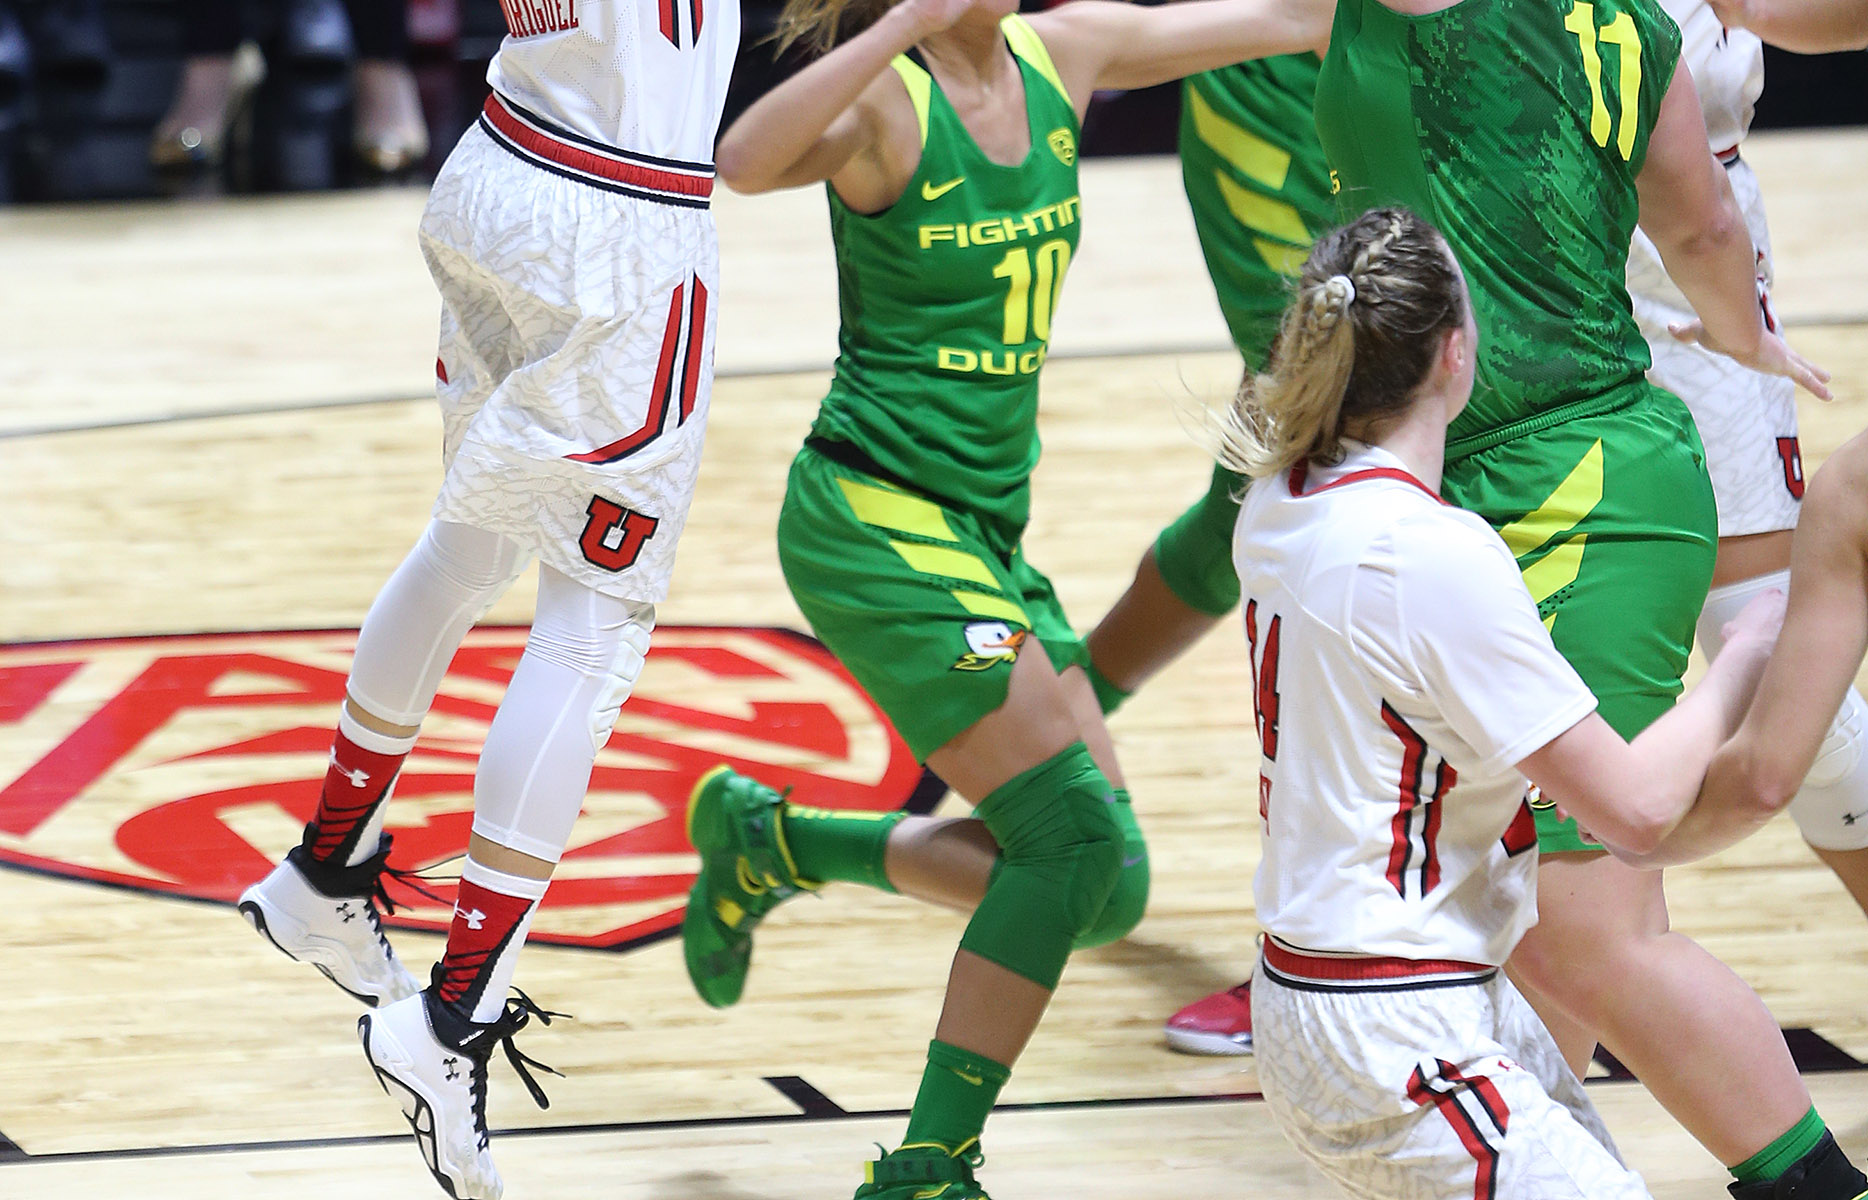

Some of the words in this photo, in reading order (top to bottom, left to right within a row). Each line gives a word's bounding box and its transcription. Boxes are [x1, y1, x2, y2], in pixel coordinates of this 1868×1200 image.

[1564, 0, 1642, 162] 11
[918, 195, 1081, 249] FIGHTIN
[992, 238, 1071, 345] 10
[578, 494, 660, 573] U
